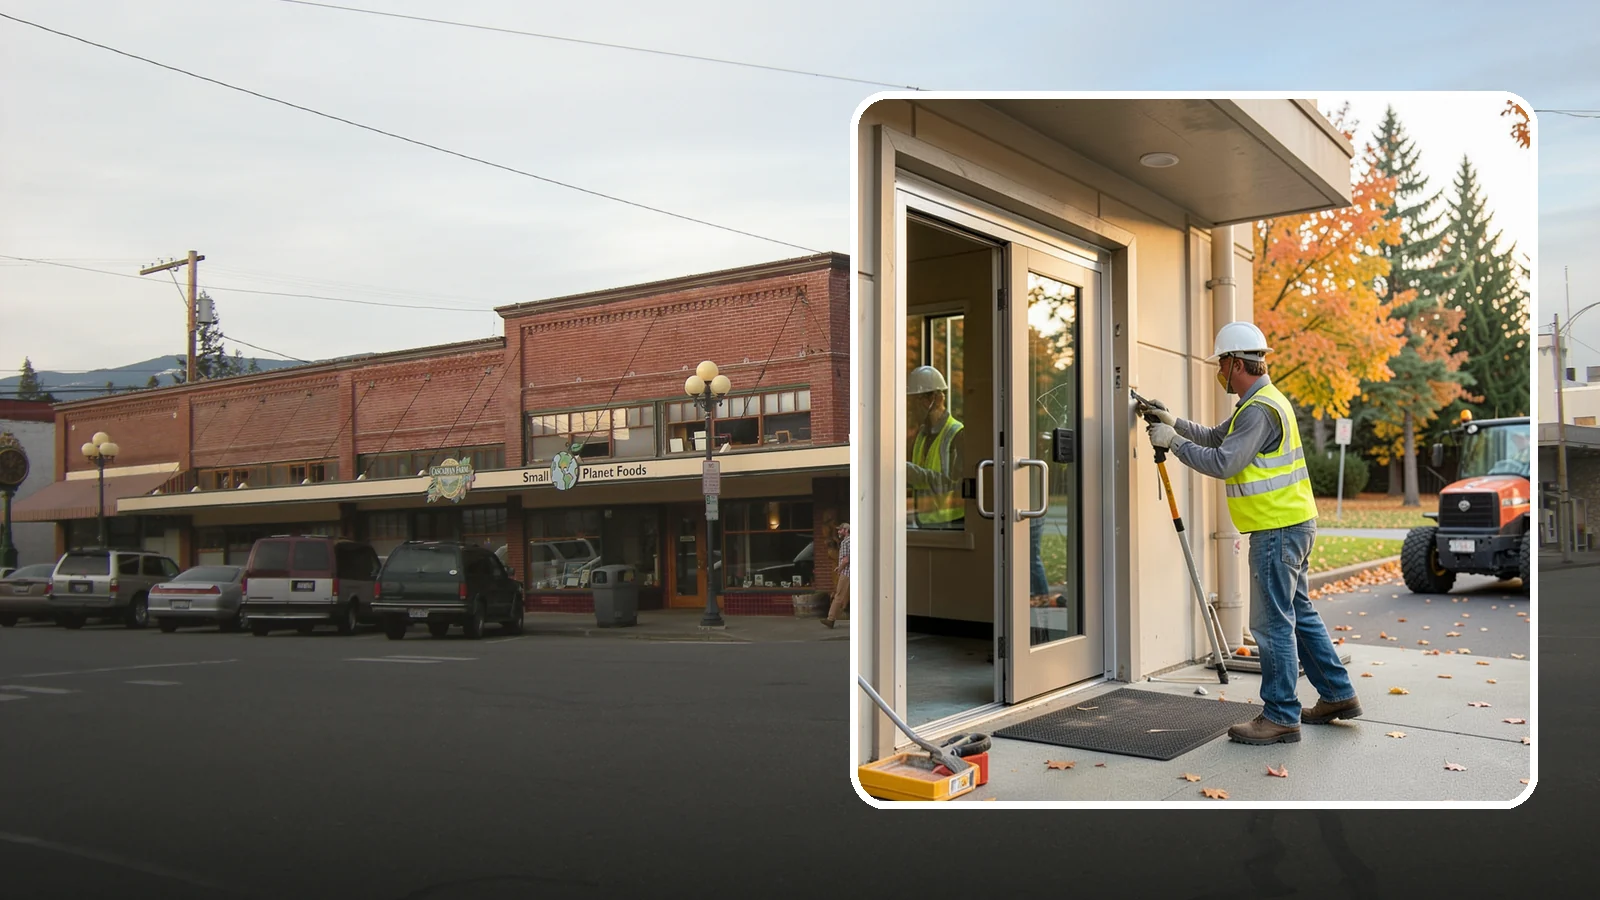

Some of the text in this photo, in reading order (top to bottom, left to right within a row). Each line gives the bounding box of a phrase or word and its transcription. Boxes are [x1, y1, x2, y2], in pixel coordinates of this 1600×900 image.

[523, 464, 647, 482] Small Planet Foods
